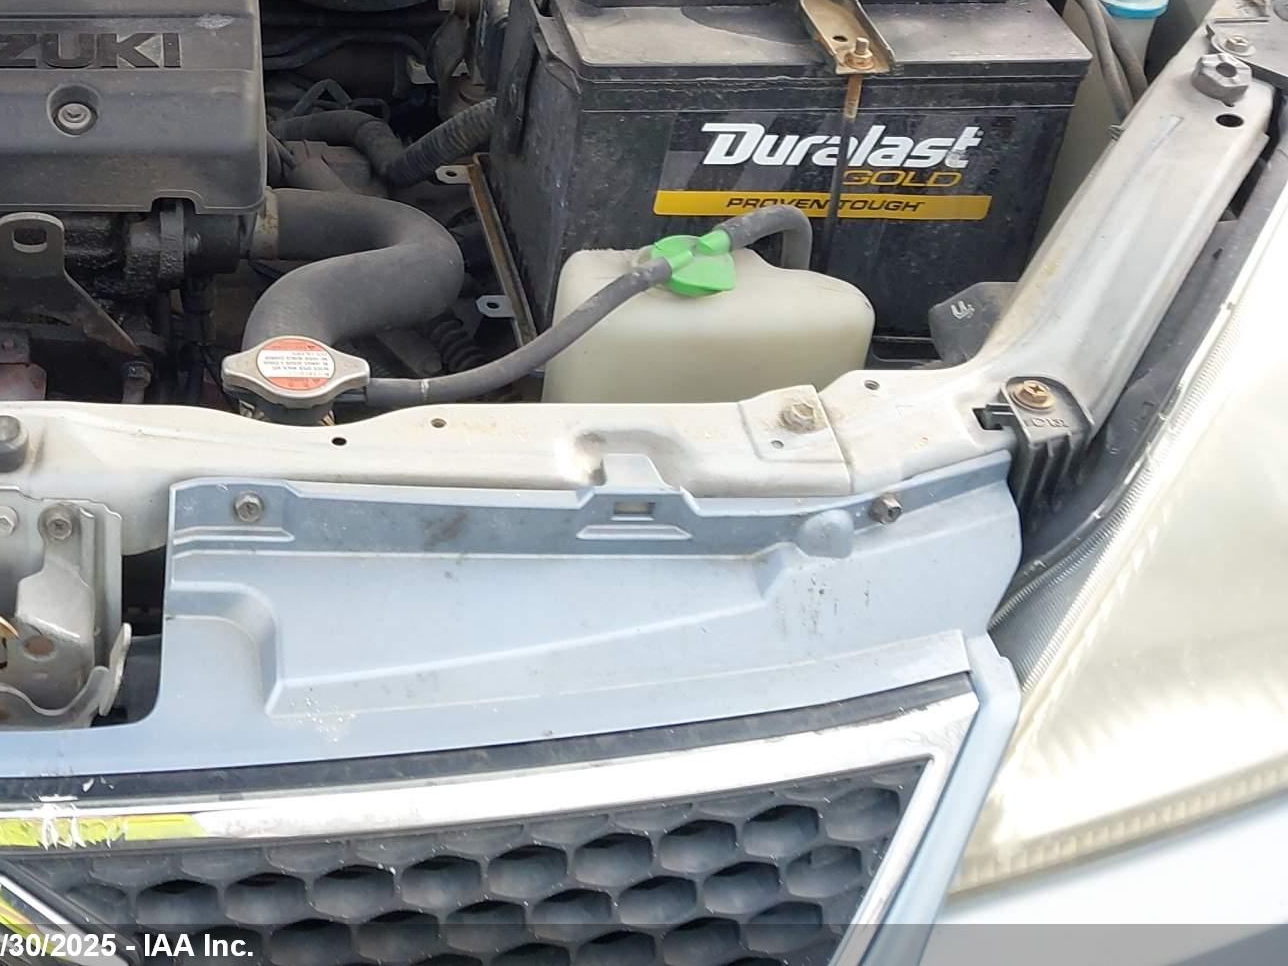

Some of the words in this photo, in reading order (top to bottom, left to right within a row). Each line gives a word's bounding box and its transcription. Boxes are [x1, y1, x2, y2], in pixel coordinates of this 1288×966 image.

[700, 122, 982, 169] Duralast
[843, 170, 963, 188] GOLD
[725, 197, 831, 212] PROVEN
[836, 198, 925, 212] TOUGH
